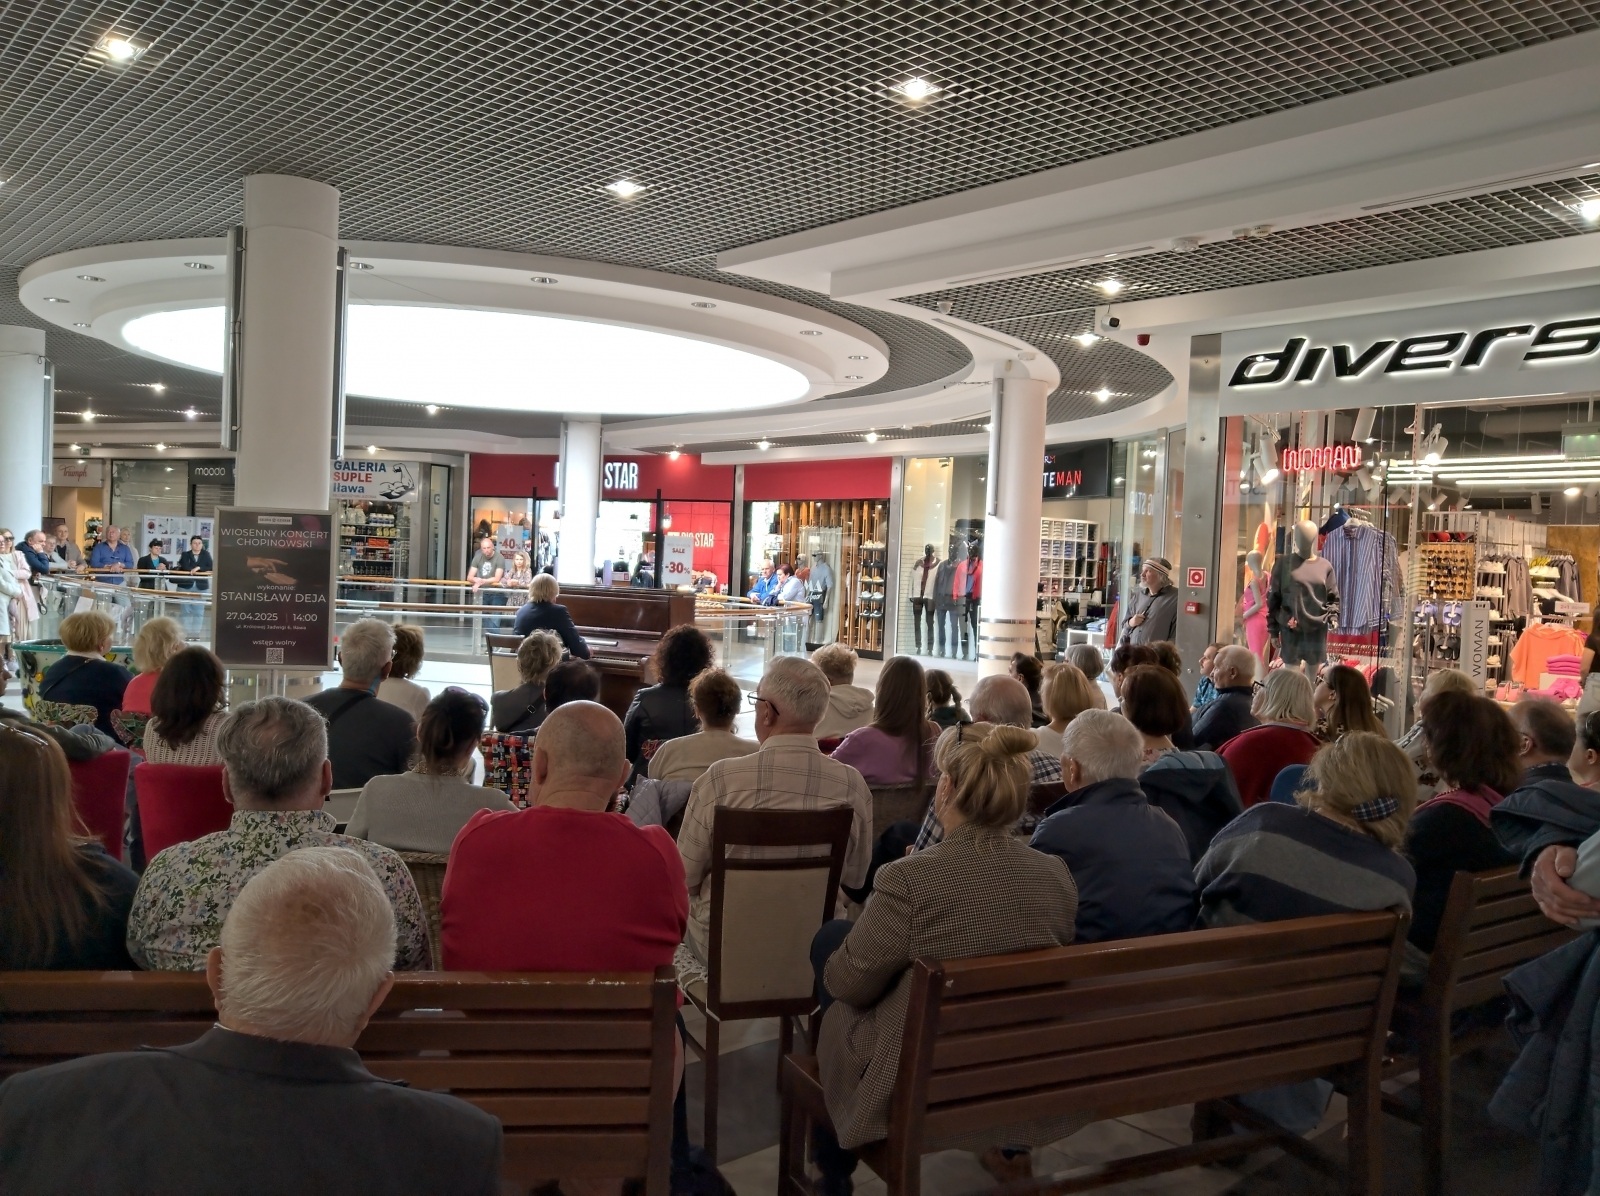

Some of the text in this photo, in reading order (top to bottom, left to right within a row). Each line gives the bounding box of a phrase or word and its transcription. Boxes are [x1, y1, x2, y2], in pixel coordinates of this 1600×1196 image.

[333, 461, 386, 472] GALERIA
[58, 464, 88, 482] Triumph
[333, 472, 372, 482] SUPLE
[604, 462, 639, 489] STAR
[221, 528, 329, 539] WIOSENNY KONCERT
[236, 538, 313, 547] CHOPINOWSKI
[695, 533, 714, 547] STAR
[221, 592, 326, 603] STANISŁAW DEJA
[226, 612, 318, 622] 27.04.2025 14:00
[1472, 620, 1484, 677] WOMAN
